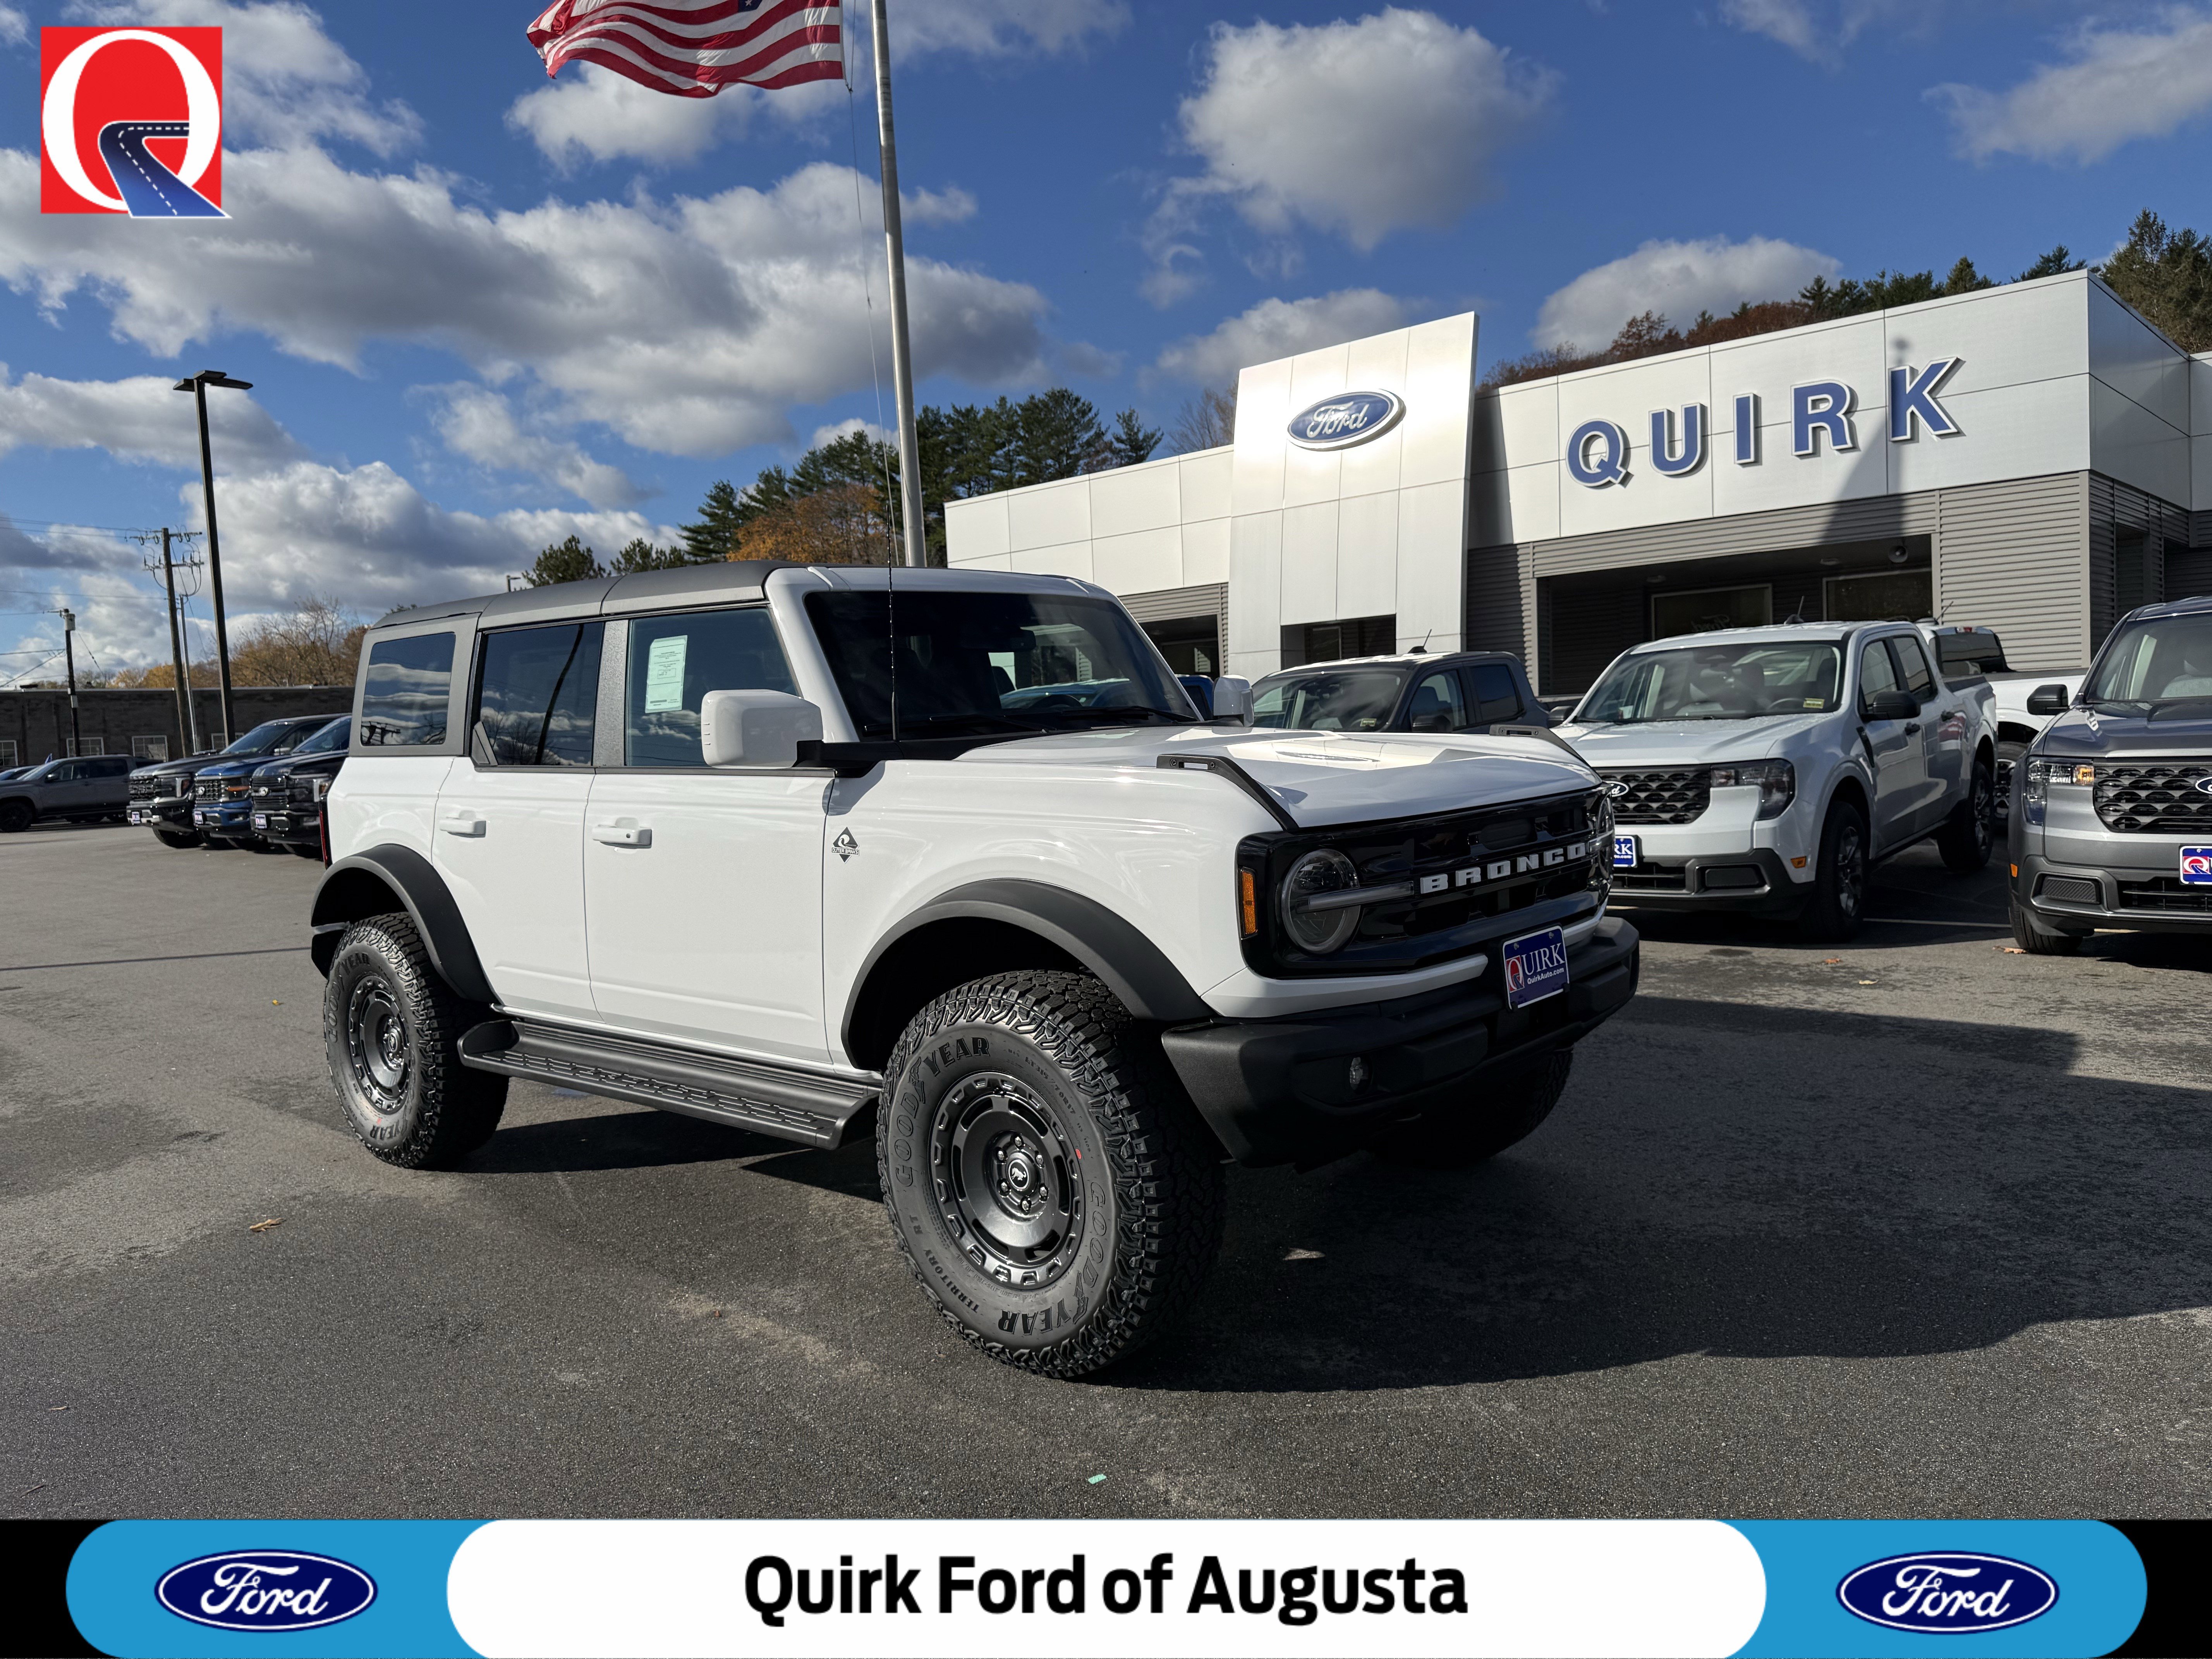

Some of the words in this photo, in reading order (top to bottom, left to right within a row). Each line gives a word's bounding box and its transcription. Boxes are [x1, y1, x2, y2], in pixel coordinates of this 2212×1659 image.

[1306, 401, 1370, 438] Ford
[1565, 356, 1962, 487] QUIRK
[1420, 842, 1586, 894] BRONCO
[1508, 943, 1565, 990] QUIRK
[1527, 967, 1564, 984] QuirkAuto.com
[910, 1214, 923, 1235] RT
[923, 1249, 979, 1314] TERRITORY
